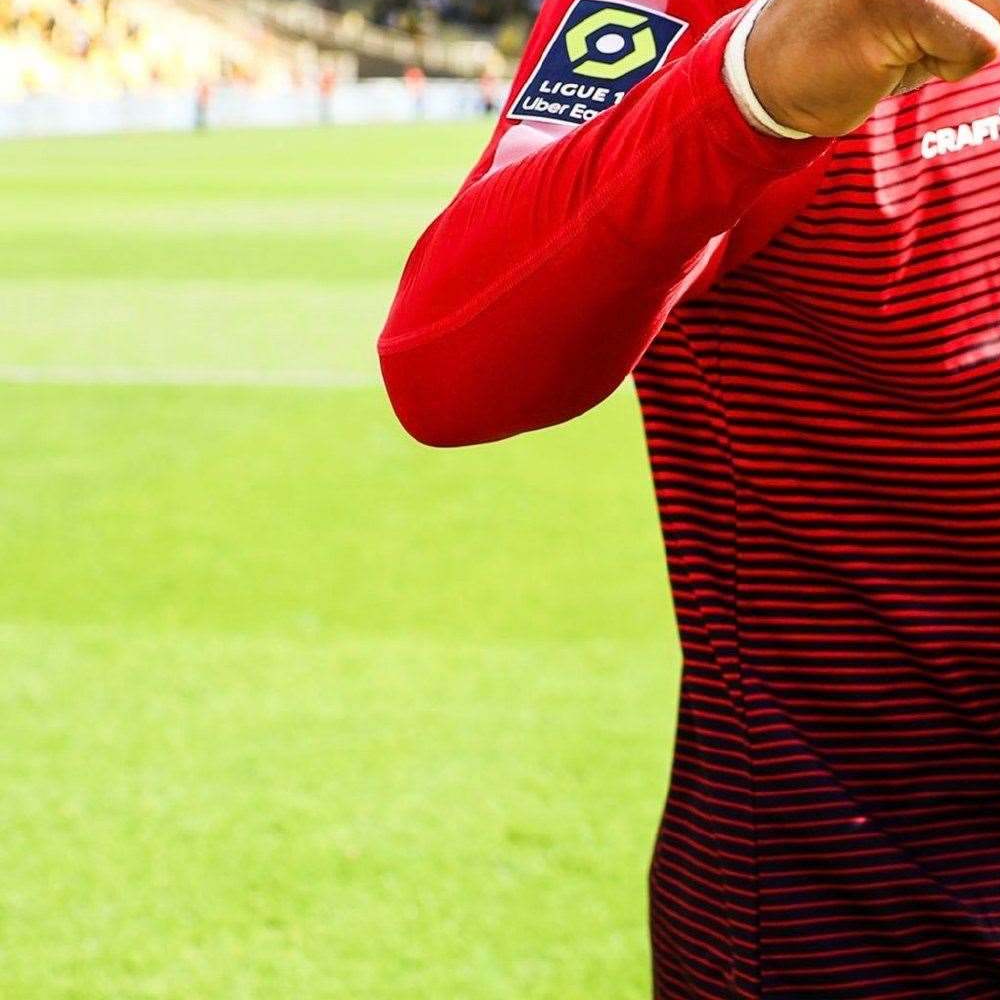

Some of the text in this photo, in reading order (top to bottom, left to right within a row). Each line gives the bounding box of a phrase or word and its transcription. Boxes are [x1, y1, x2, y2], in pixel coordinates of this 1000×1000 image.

[539, 80, 626, 107] LIGUE 1
[522, 96, 600, 121] Uber Ea
[920, 114, 1000, 160] CRAFT
